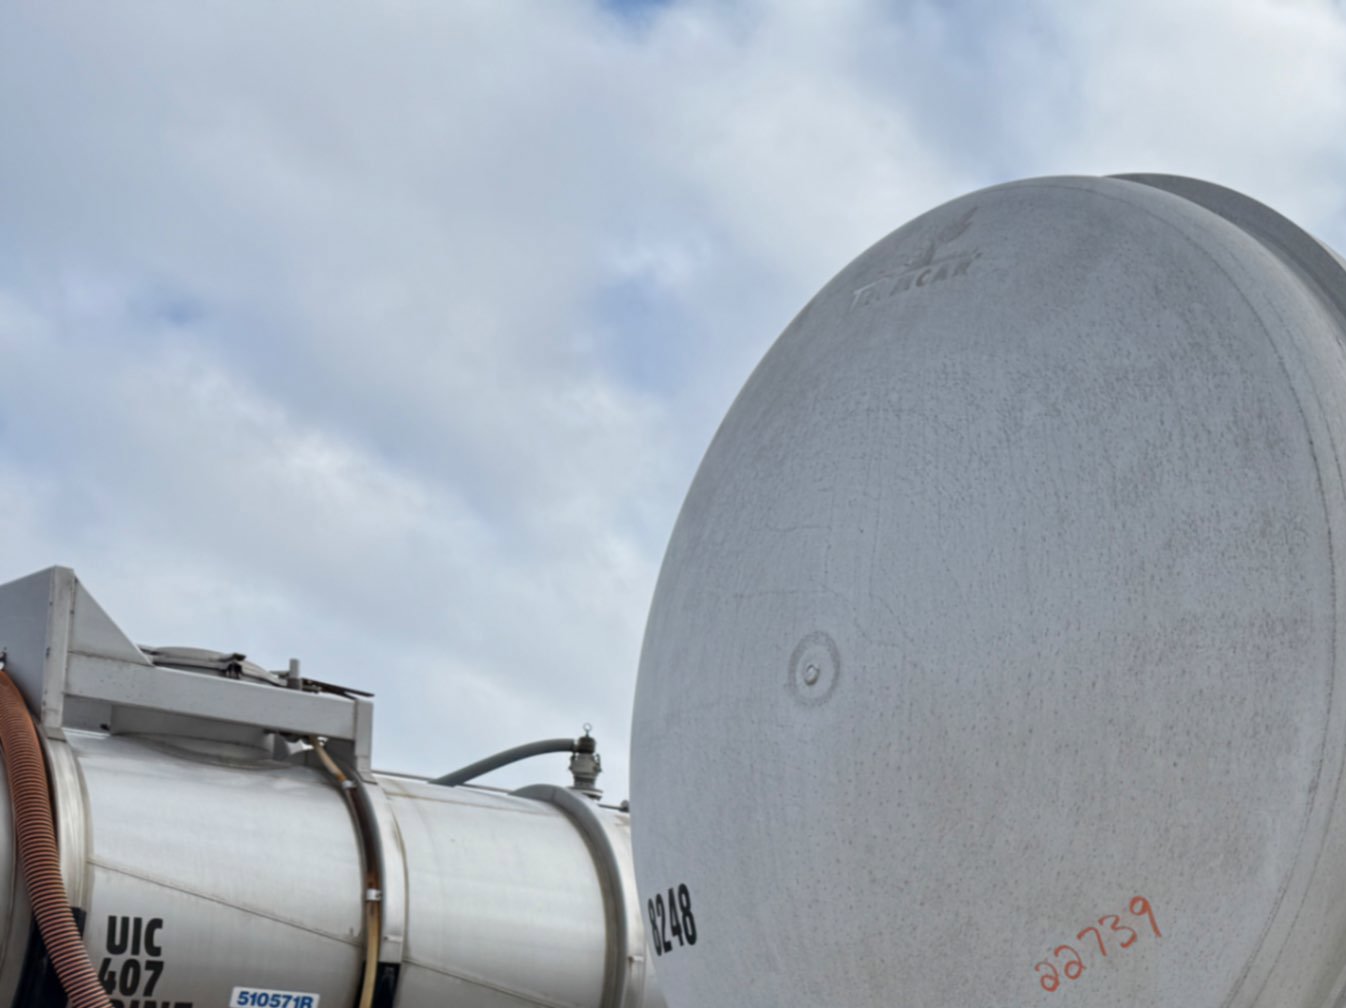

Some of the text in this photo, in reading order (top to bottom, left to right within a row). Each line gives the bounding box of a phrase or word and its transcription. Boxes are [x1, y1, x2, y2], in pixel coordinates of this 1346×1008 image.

[106, 915, 163, 957] UIC
[647, 883, 697, 957] 8248
[1034, 895, 1162, 992] 22739
[98, 957, 164, 997] 407
